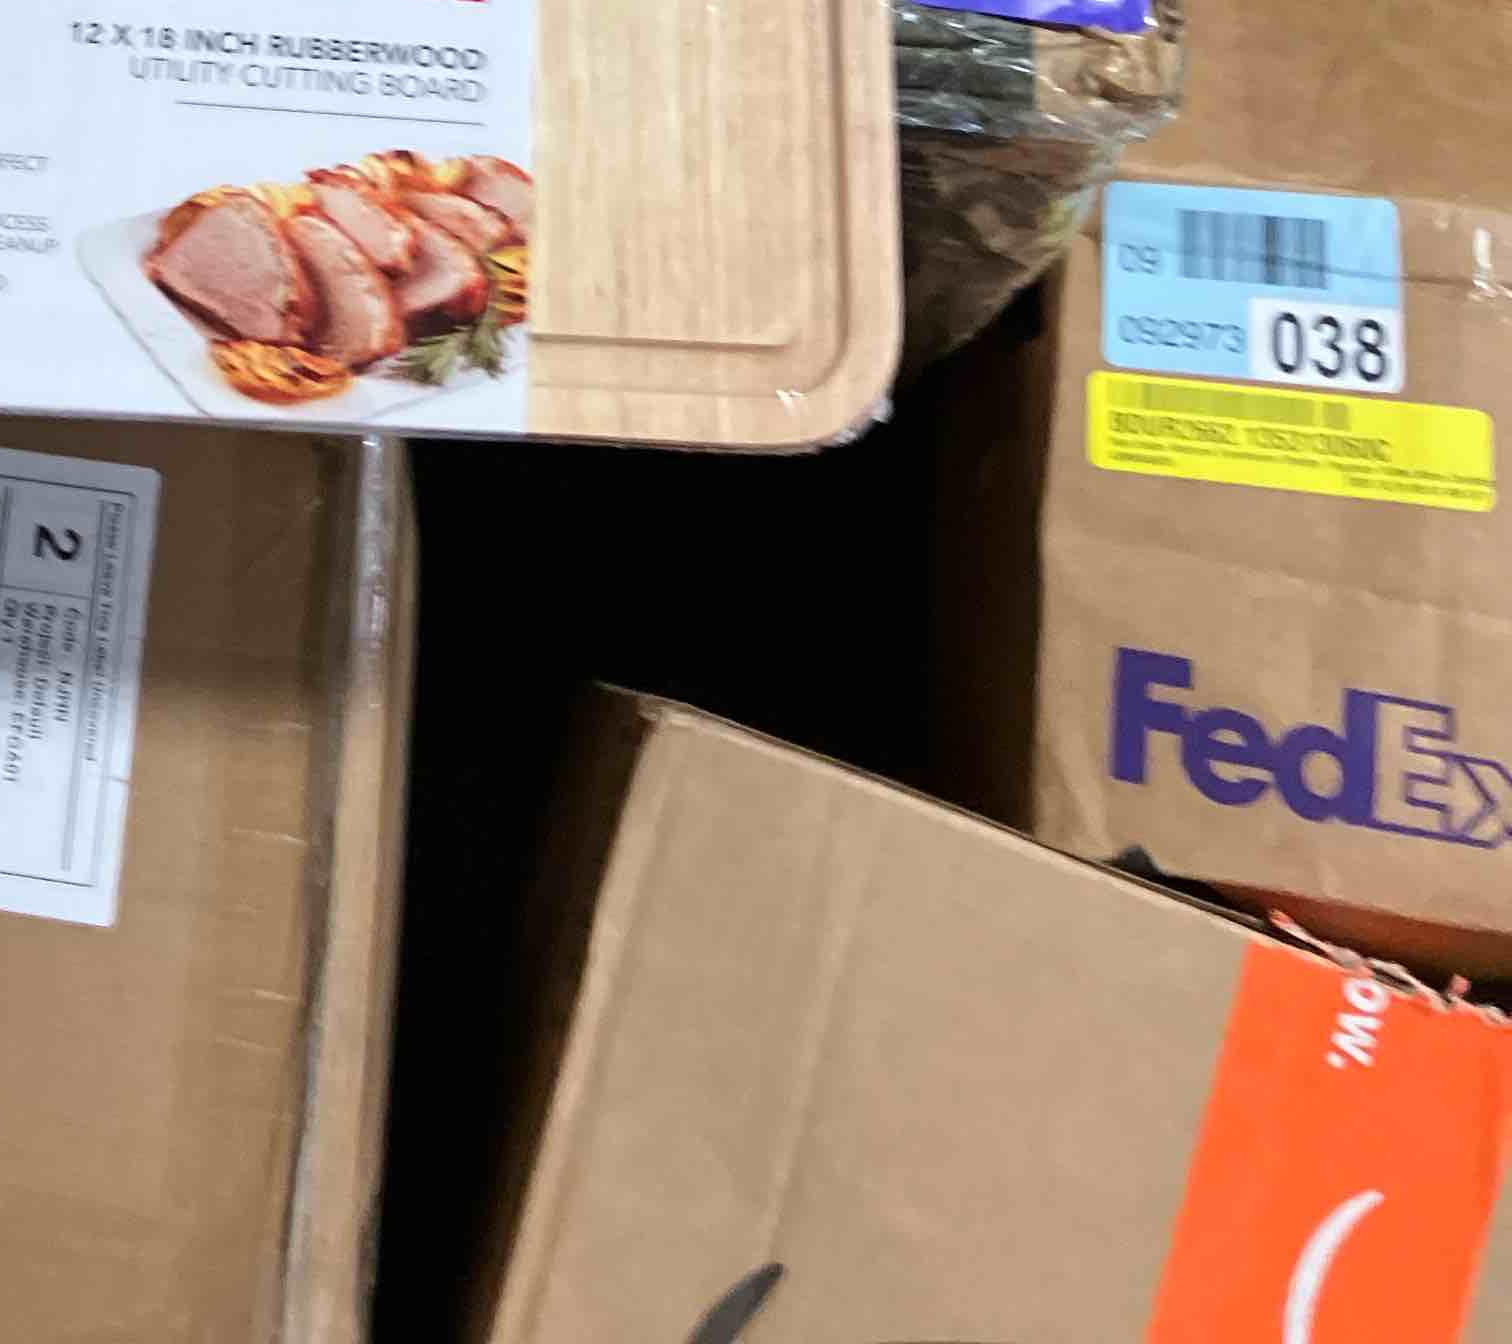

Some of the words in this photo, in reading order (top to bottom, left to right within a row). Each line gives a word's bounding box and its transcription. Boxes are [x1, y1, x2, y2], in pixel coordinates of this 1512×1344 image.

[68, 20, 103, 47] 12
[110, 23, 134, 48] X
[143, 25, 175, 50] 18
[184, 28, 260, 56] INCH
[266, 33, 488, 71] RUBBERWOOD
[127, 56, 232, 86] UTILITY
[238, 62, 372, 96] CUTTING
[378, 72, 488, 103] BOARD
[1271, 310, 1388, 383] 038
[33, 523, 83, 561] 2
